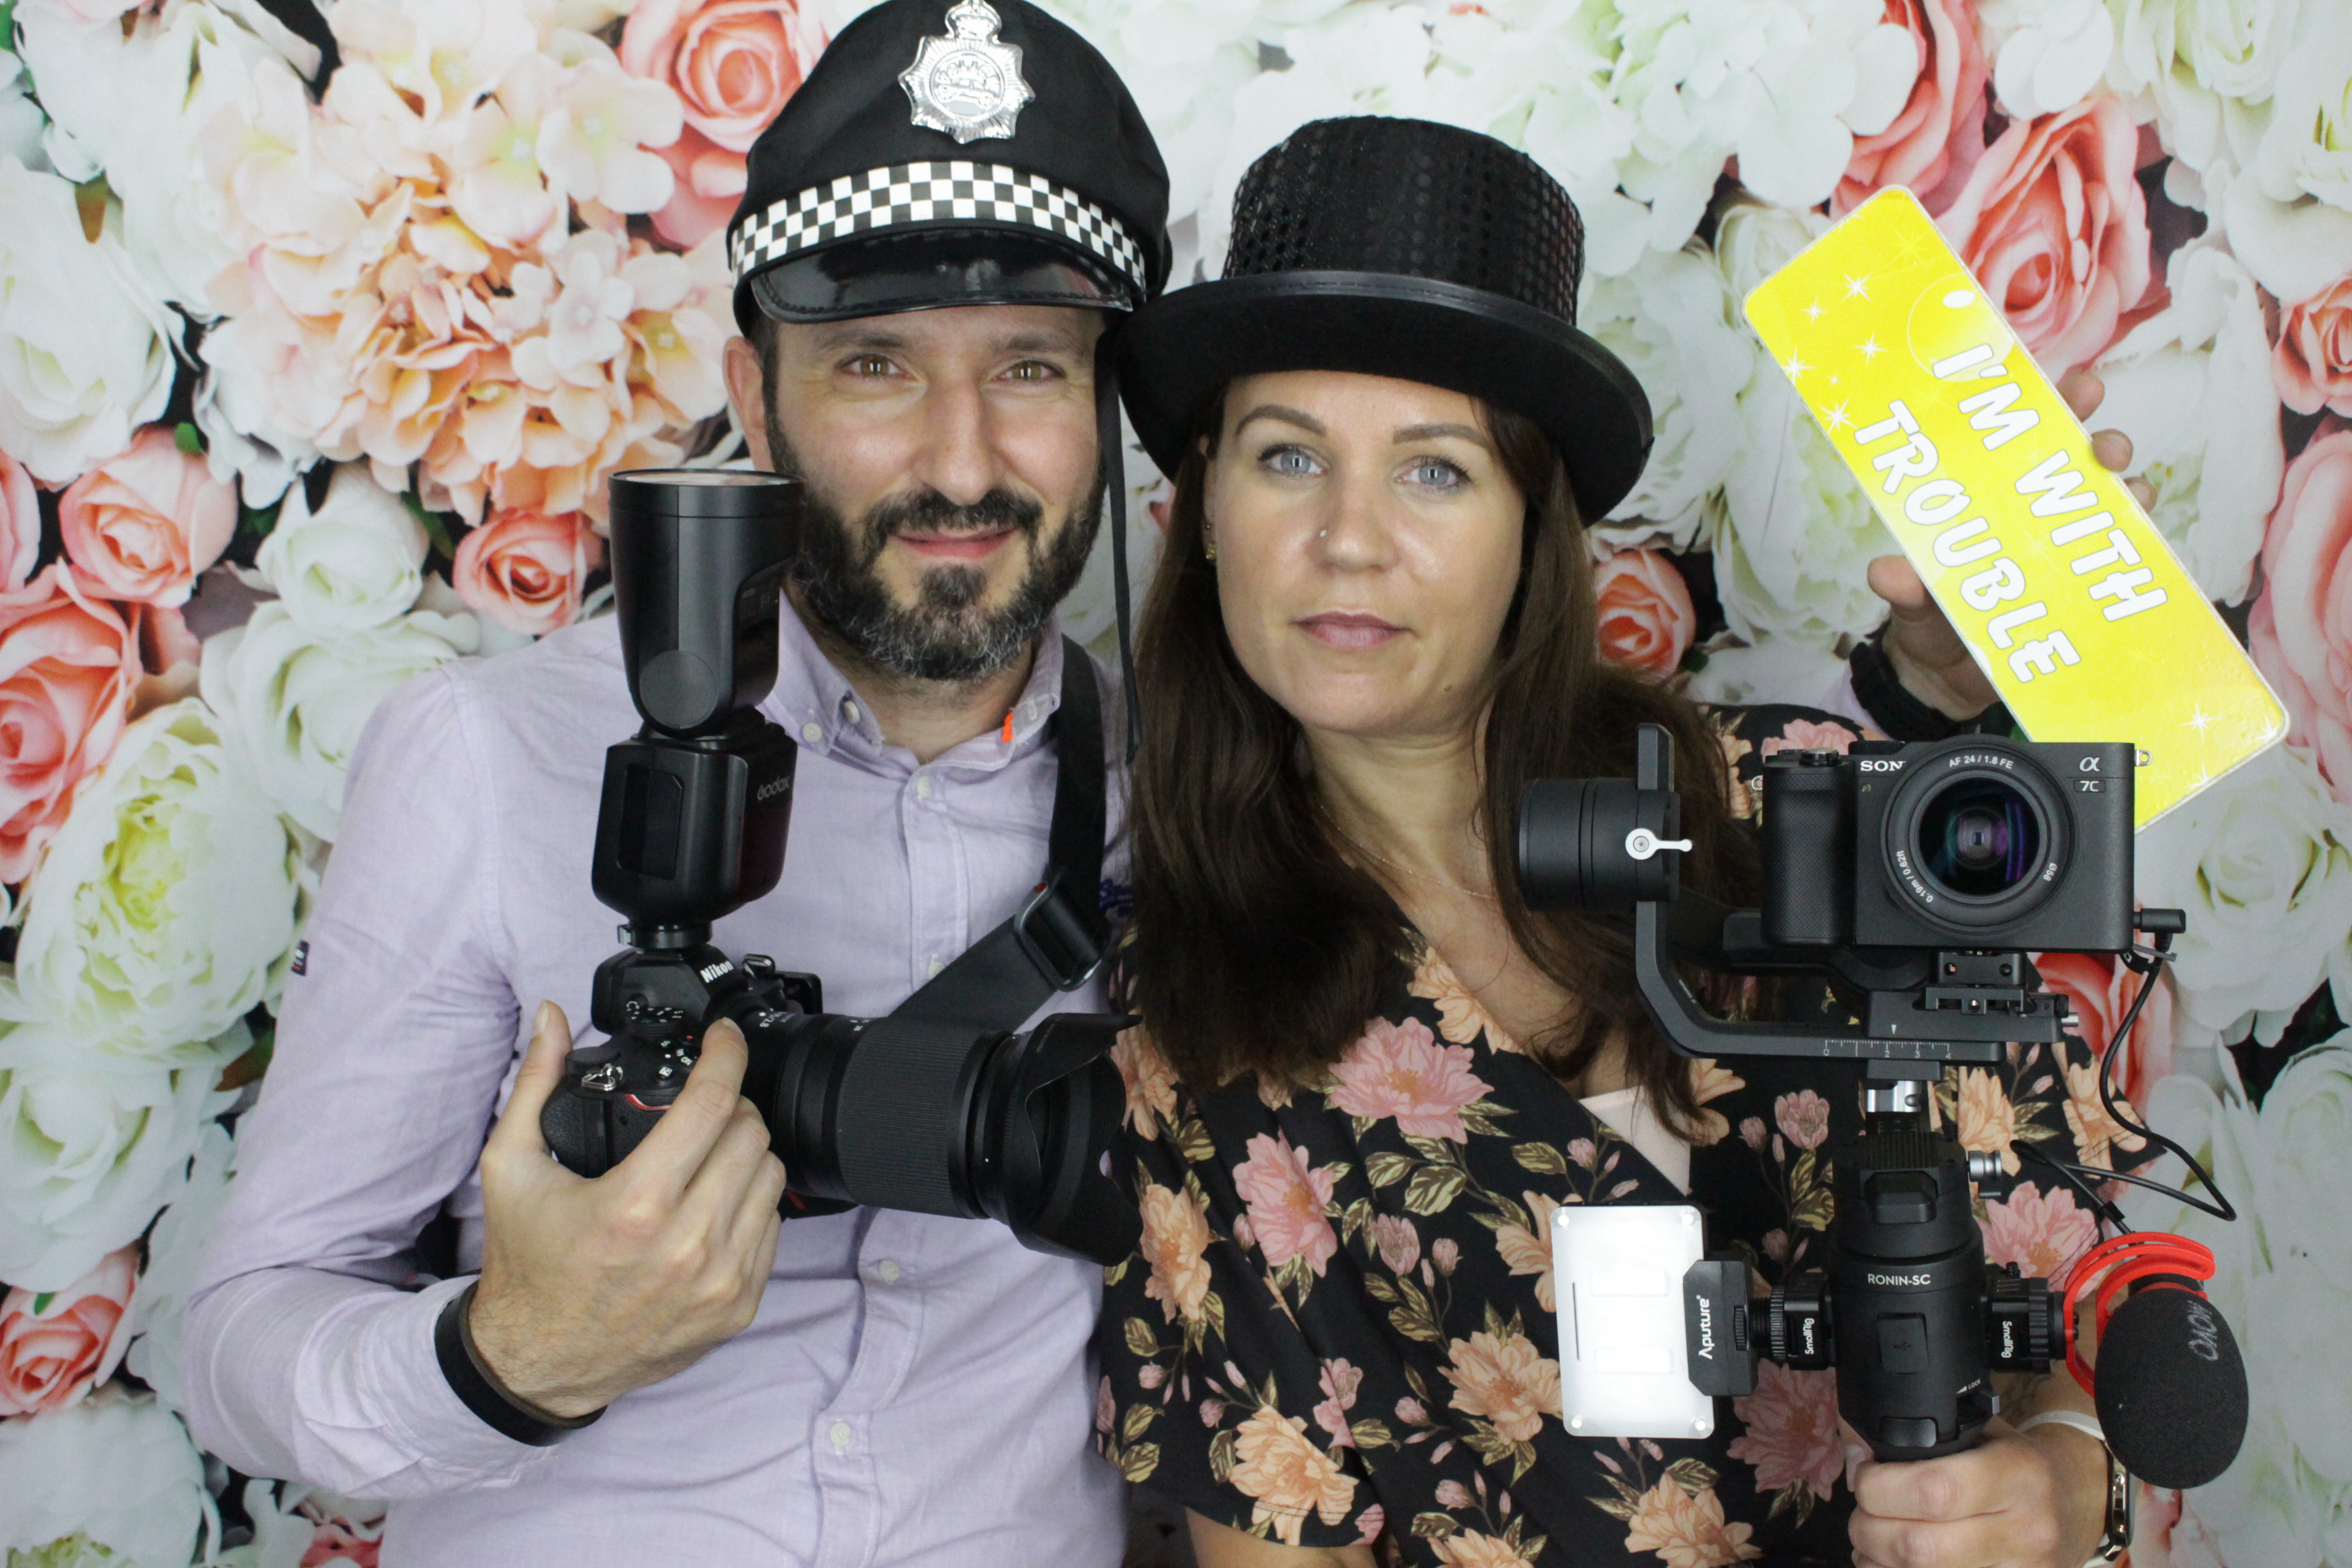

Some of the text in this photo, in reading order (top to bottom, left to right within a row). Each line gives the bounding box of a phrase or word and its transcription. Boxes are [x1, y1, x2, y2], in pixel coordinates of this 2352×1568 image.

[1931, 342, 2168, 622] I'M WITH
[1853, 399, 2082, 683] TROUBLE
[1860, 760, 1906, 772] SON
[1949, 757, 1961, 768] AF
[1964, 755, 1975, 764] 24
[1984, 755, 1997, 765] 1.8
[1999, 759, 2014, 770] FE
[757, 775, 791, 801] Godox
[2080, 781, 2100, 792] 7C
[1896, 850, 1911, 875] 0.62ft
[1911, 879, 1933, 903] 0.19m
[700, 960, 734, 983] Nikon
[1884, 1050, 1891, 1058] 2
[1914, 1051, 1921, 1059] 3
[1867, 1273, 1931, 1286] RONIN-SC
[1699, 1297, 1715, 1360] Aputure
[1803, 1318, 1815, 1355] SmallRig
[2001, 1321, 2014, 1358] SmallRig
[1968, 1378, 1981, 1390] LOCK
